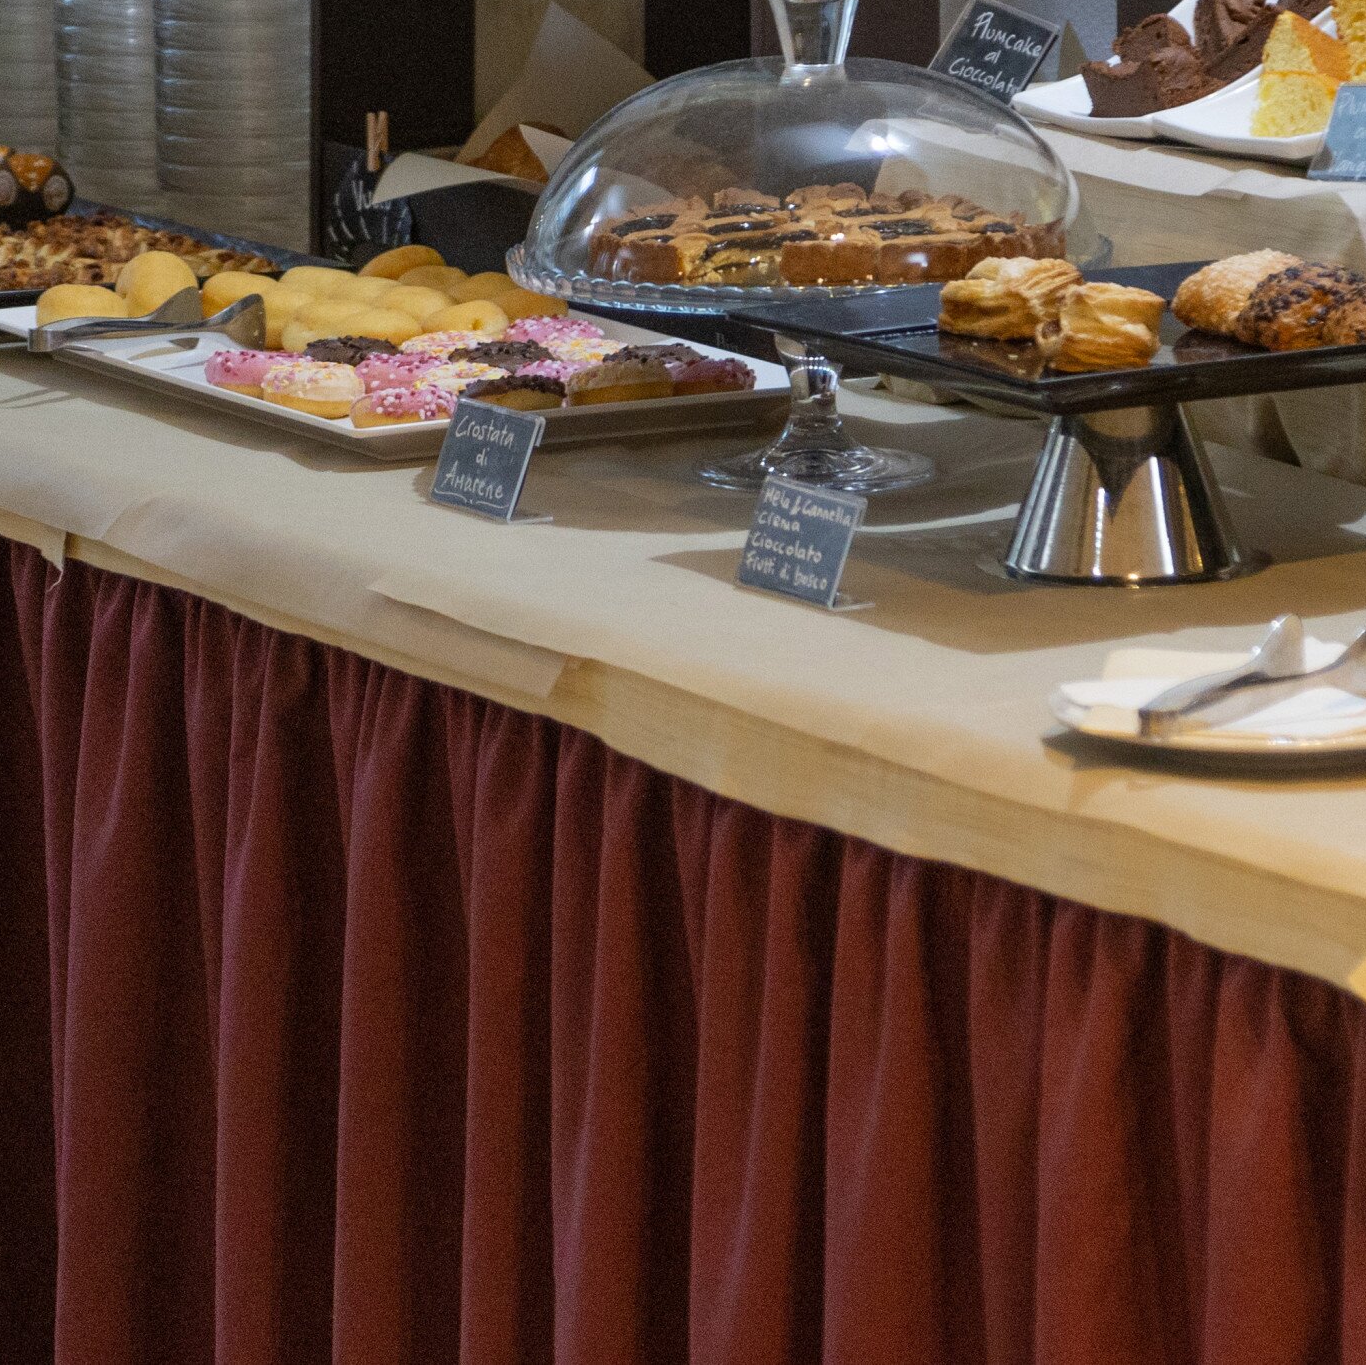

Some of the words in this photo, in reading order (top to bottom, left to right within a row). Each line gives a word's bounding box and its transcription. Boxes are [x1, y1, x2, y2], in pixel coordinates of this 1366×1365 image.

[984, 50, 1002, 65] al
[455, 415, 515, 449] Crostata
[476, 447, 490, 465] di
